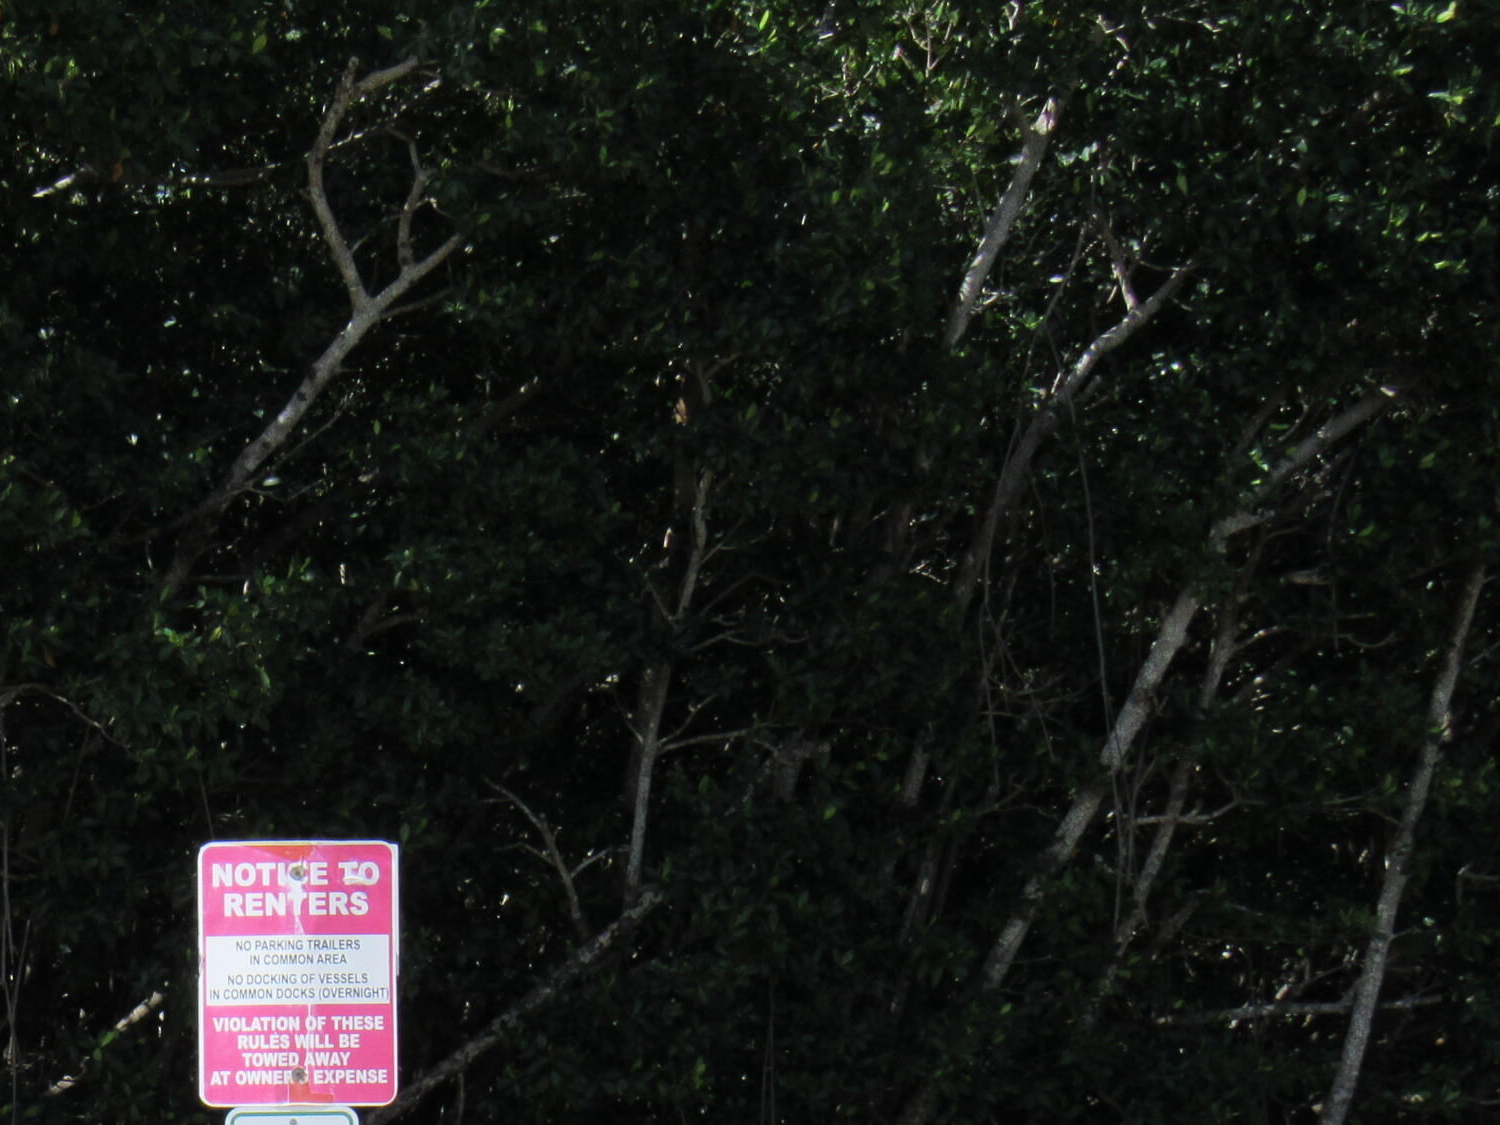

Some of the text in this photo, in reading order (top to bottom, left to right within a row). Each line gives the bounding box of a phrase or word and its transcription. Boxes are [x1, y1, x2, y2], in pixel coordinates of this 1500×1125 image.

[338, 861, 380, 886] TO
[224, 892, 369, 917] RENTERS
[236, 939, 361, 951] NO PARKING TRAILERS
[250, 954, 347, 965] IN COMMON AREA
[228, 973, 368, 985] NO DOCKING OF VESSELS
[210, 987, 389, 1000] IN COMMON DOCKS (OVERNIGHT)
[213, 1016, 384, 1032] VIOLATION OF THESE
[237, 1033, 360, 1050] RULES WILL BE
[242, 1052, 351, 1067] TOWED AWAY
[211, 1071, 230, 1085] AT
[313, 1069, 388, 1084] EXPENSE
